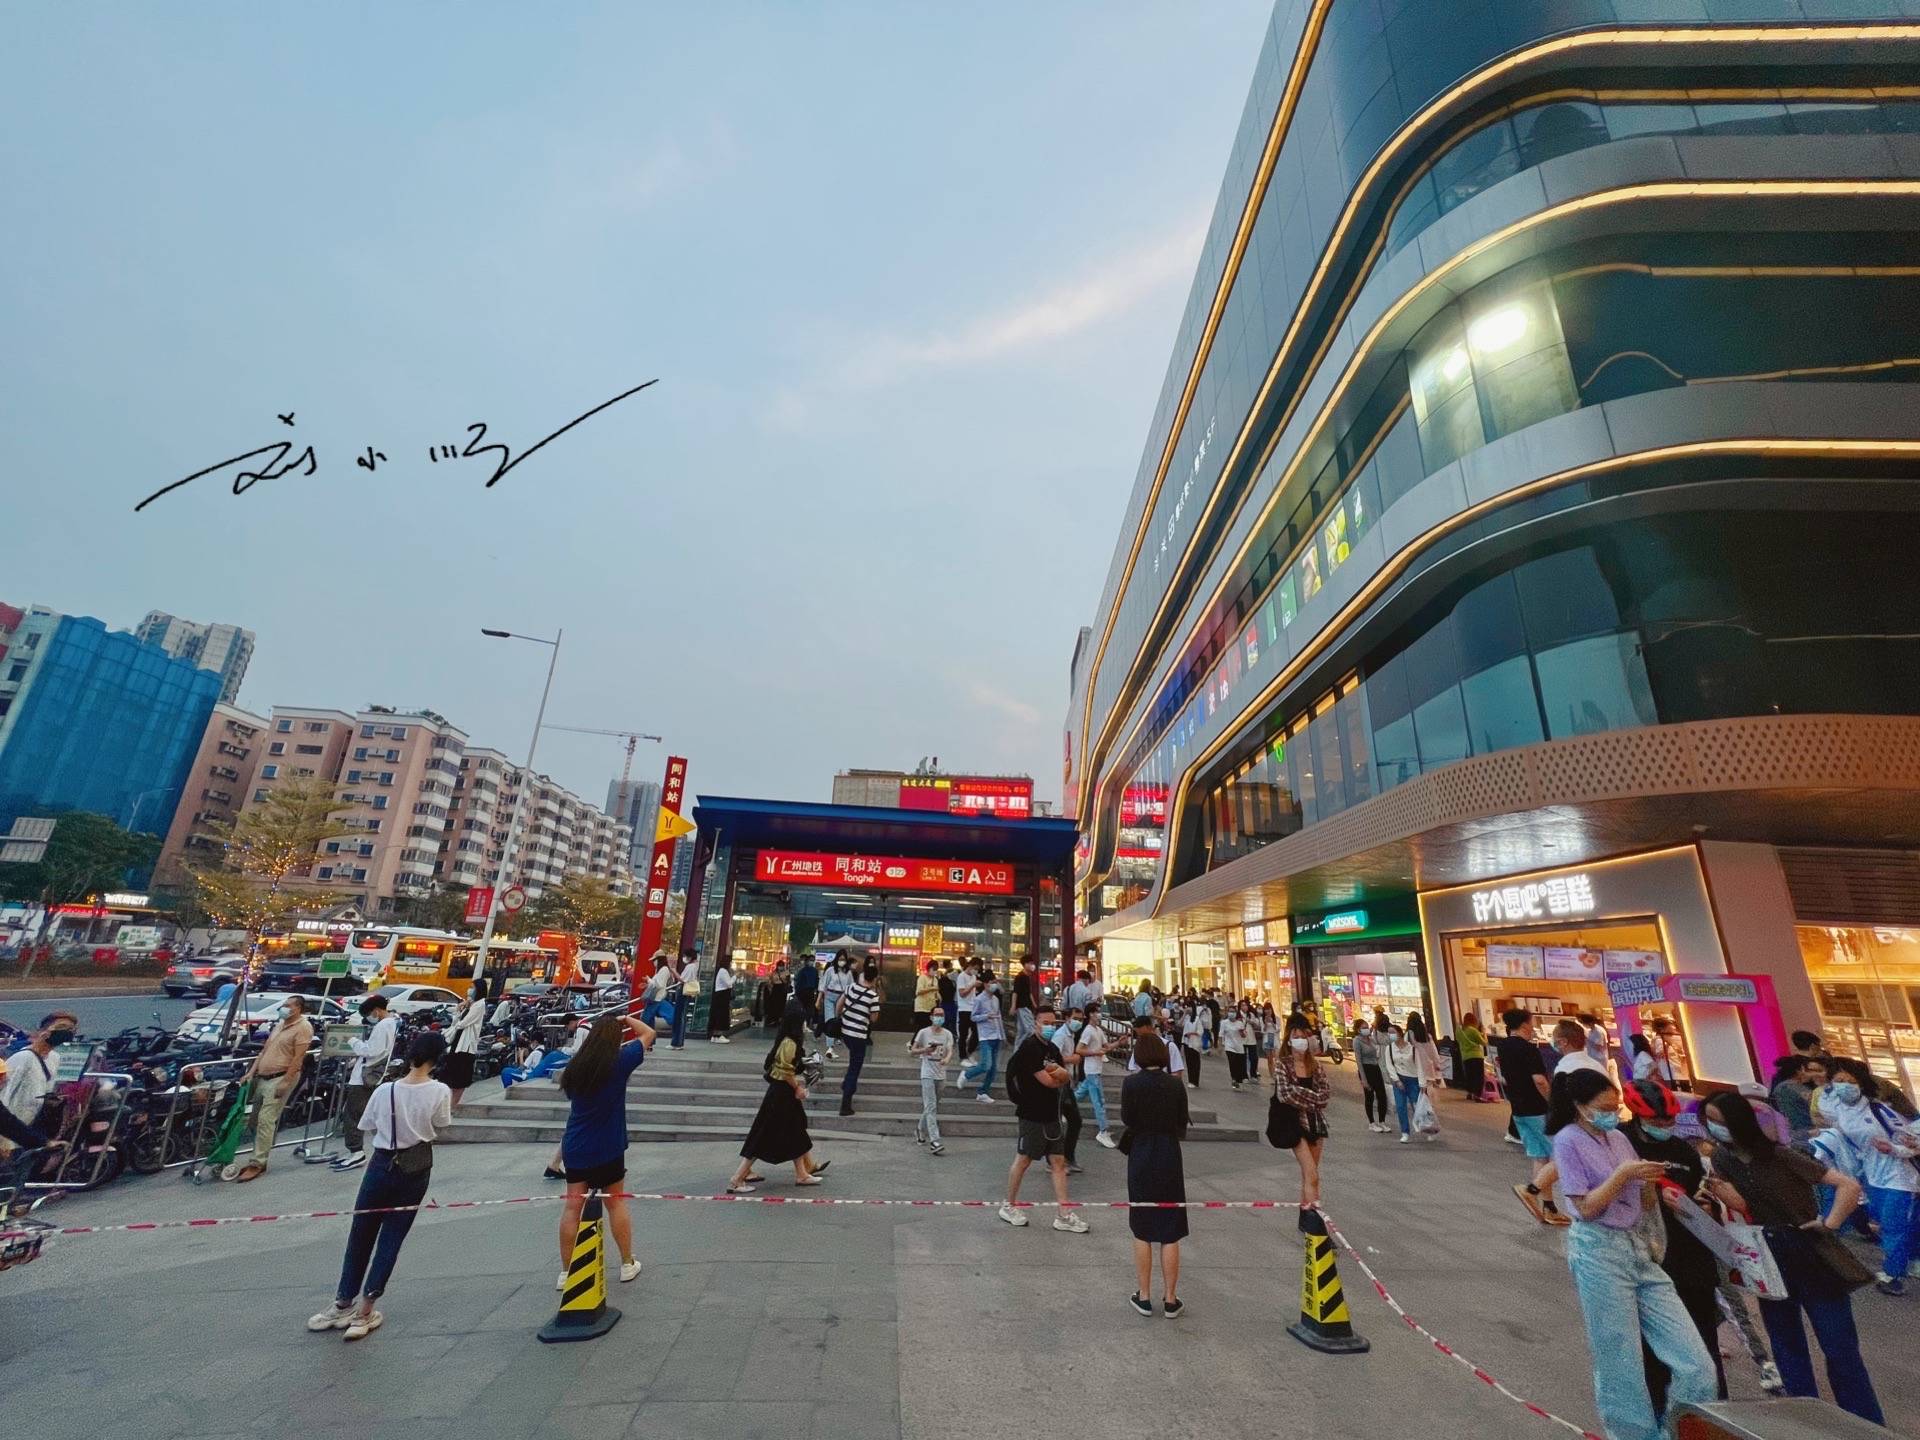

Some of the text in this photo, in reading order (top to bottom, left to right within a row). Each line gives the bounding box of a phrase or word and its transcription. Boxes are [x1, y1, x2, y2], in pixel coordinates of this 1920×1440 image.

[667, 763, 682, 803] 同和站
[655, 853, 669, 868] A
[781, 859, 823, 872] 广州地铁
[836, 857, 882, 874] 同和站
[843, 872, 874, 885] Tonghe
[967, 868, 981, 884] A
[985, 870, 1006, 881] 入口
